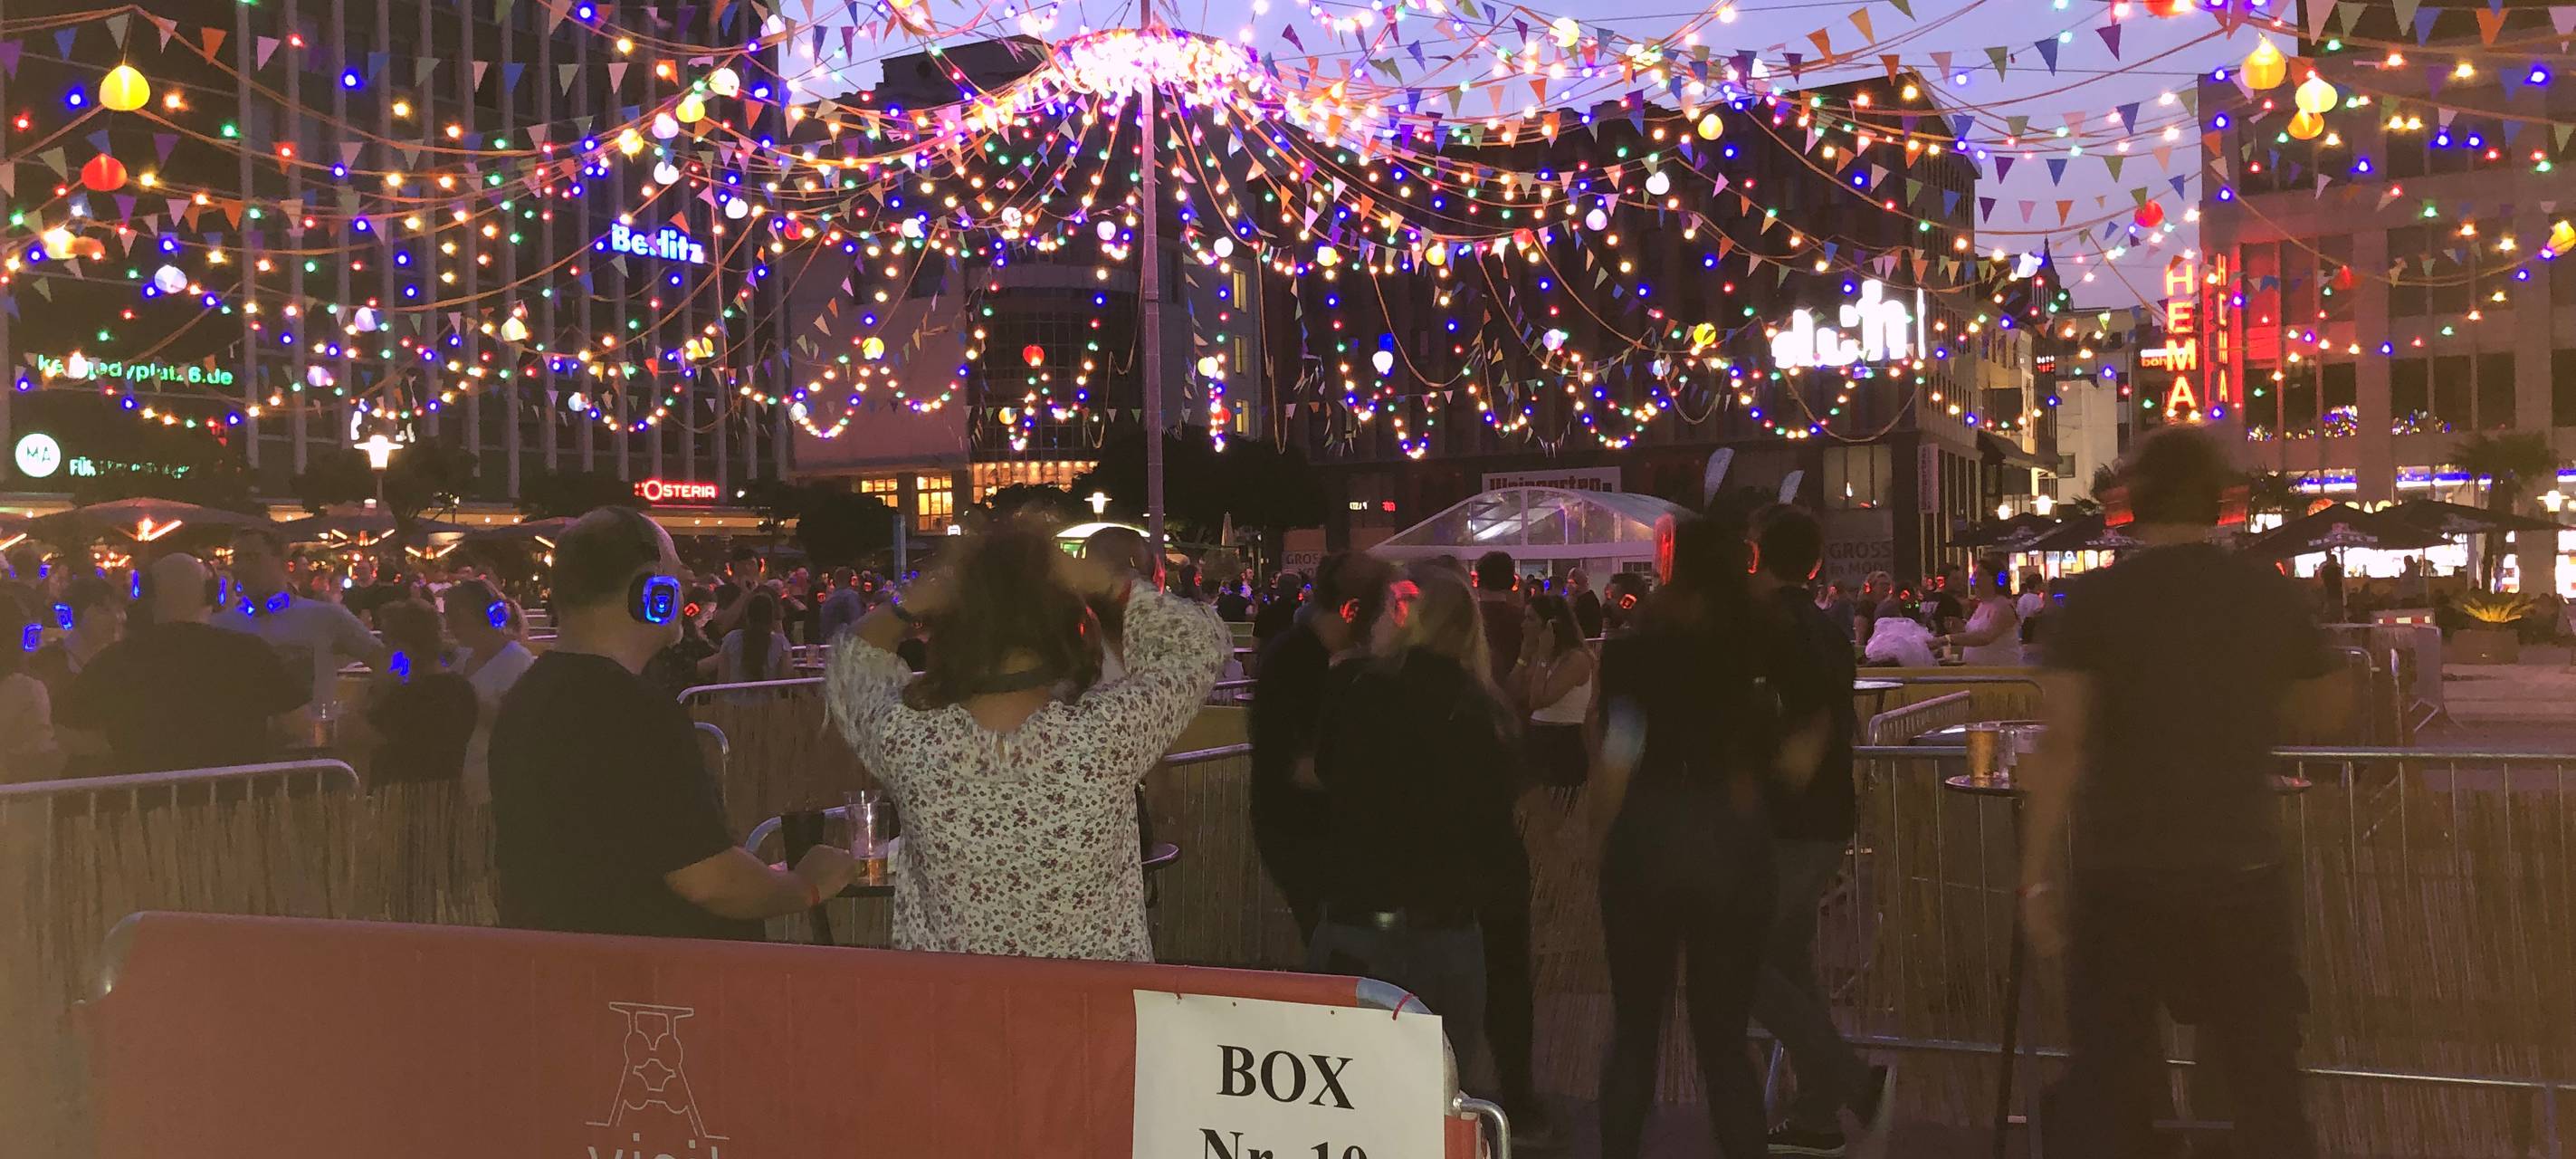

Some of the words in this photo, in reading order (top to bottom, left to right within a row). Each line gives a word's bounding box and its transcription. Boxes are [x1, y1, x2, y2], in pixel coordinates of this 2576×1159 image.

[2165, 263, 2197, 410] HEMA
[38, 354, 234, 386] keedyplat6.de
[1216, 1044, 1355, 1110] BOX
